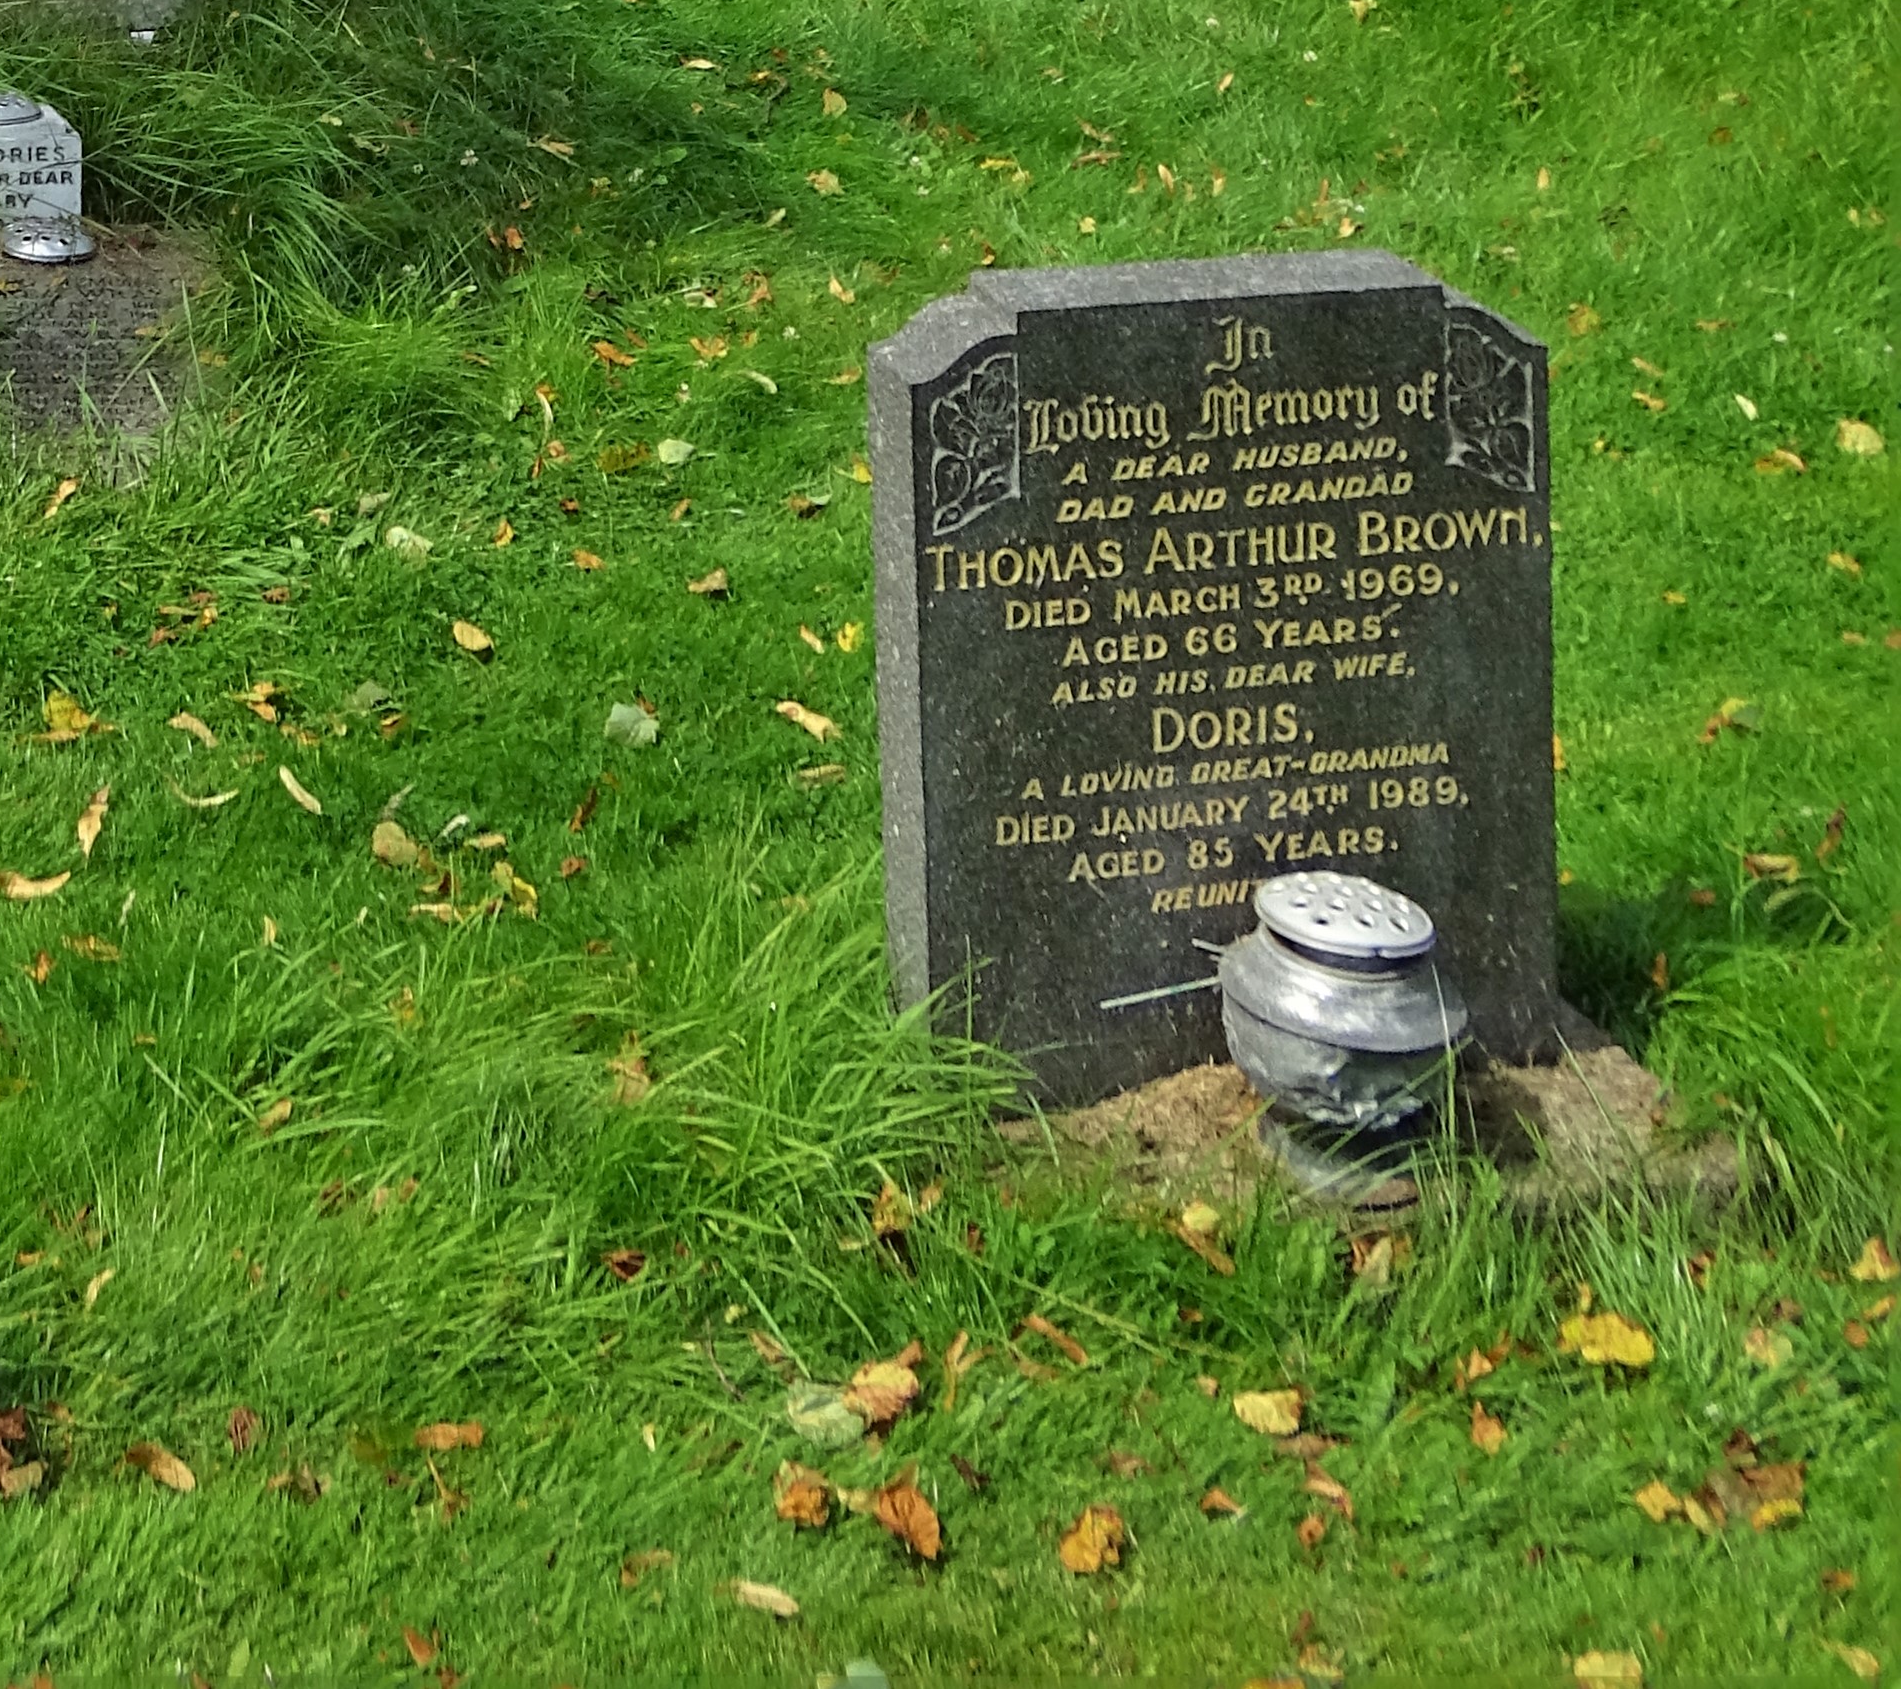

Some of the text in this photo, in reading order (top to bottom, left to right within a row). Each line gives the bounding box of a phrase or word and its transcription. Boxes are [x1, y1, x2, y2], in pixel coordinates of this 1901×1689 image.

[19, 171, 74, 185] DEAR
[1205, 315, 1274, 374] In
[1023, 370, 1438, 455] Loving Memory of
[1061, 462, 1088, 486] A
[1111, 452, 1210, 481] DEAR
[1055, 471, 1414, 523] DAD AND GRANDAD
[924, 539, 1124, 592] THOMAS
[1144, 521, 1337, 574] ARTHUR
[1004, 597, 1092, 631] DIED
[1113, 584, 1241, 624] MARCH
[1062, 633, 1169, 667] AGED
[1184, 622, 1237, 657] 66
[1051, 675, 1137, 707] ALSO
[1224, 659, 1316, 690] DEAR
[1019, 742, 1449, 801] A LOVING GREAT-GRANDMA
[996, 813, 1076, 846] DIED
[1091, 795, 1250, 837] JANUARY
[1067, 848, 1166, 883] AGED
[1187, 836, 1233, 870] 85
[1151, 878, 1265, 914] REUNI
